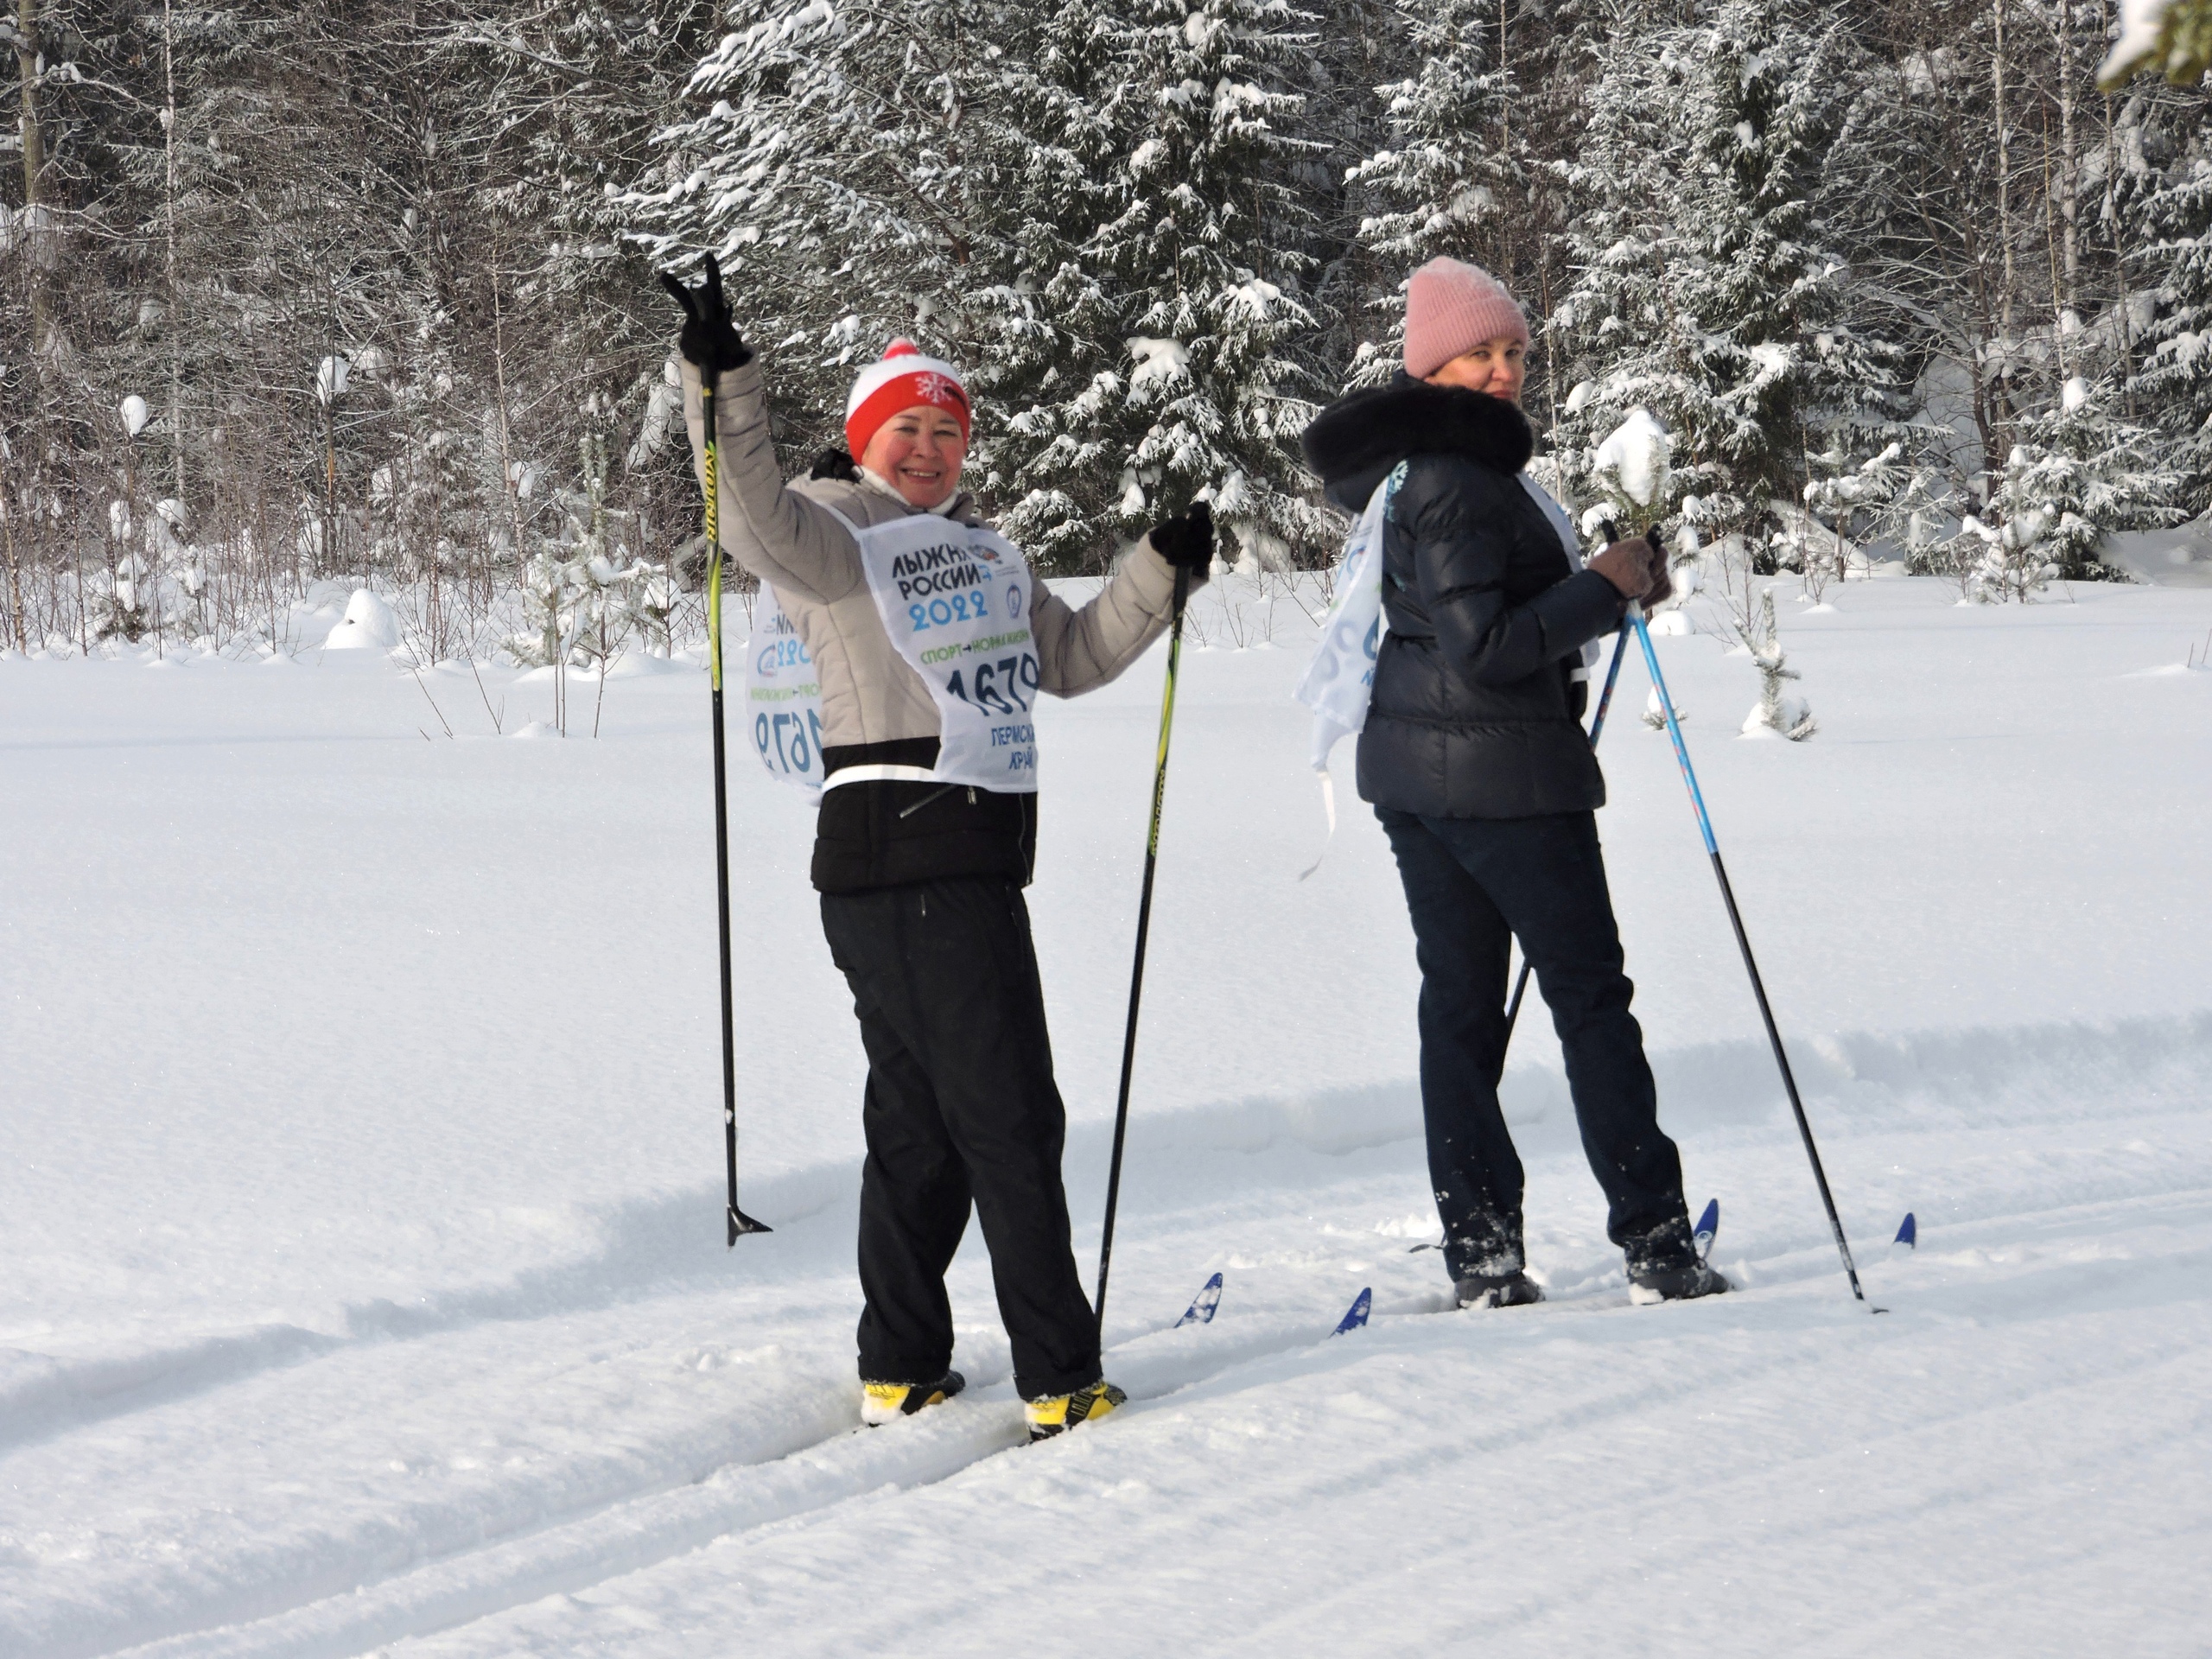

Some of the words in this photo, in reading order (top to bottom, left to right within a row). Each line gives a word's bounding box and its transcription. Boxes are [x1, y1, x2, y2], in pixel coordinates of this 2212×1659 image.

[898, 564, 982, 601] РОССИИ
[908, 590, 988, 632] 2022
[920, 642, 963, 665] СПОРТ
